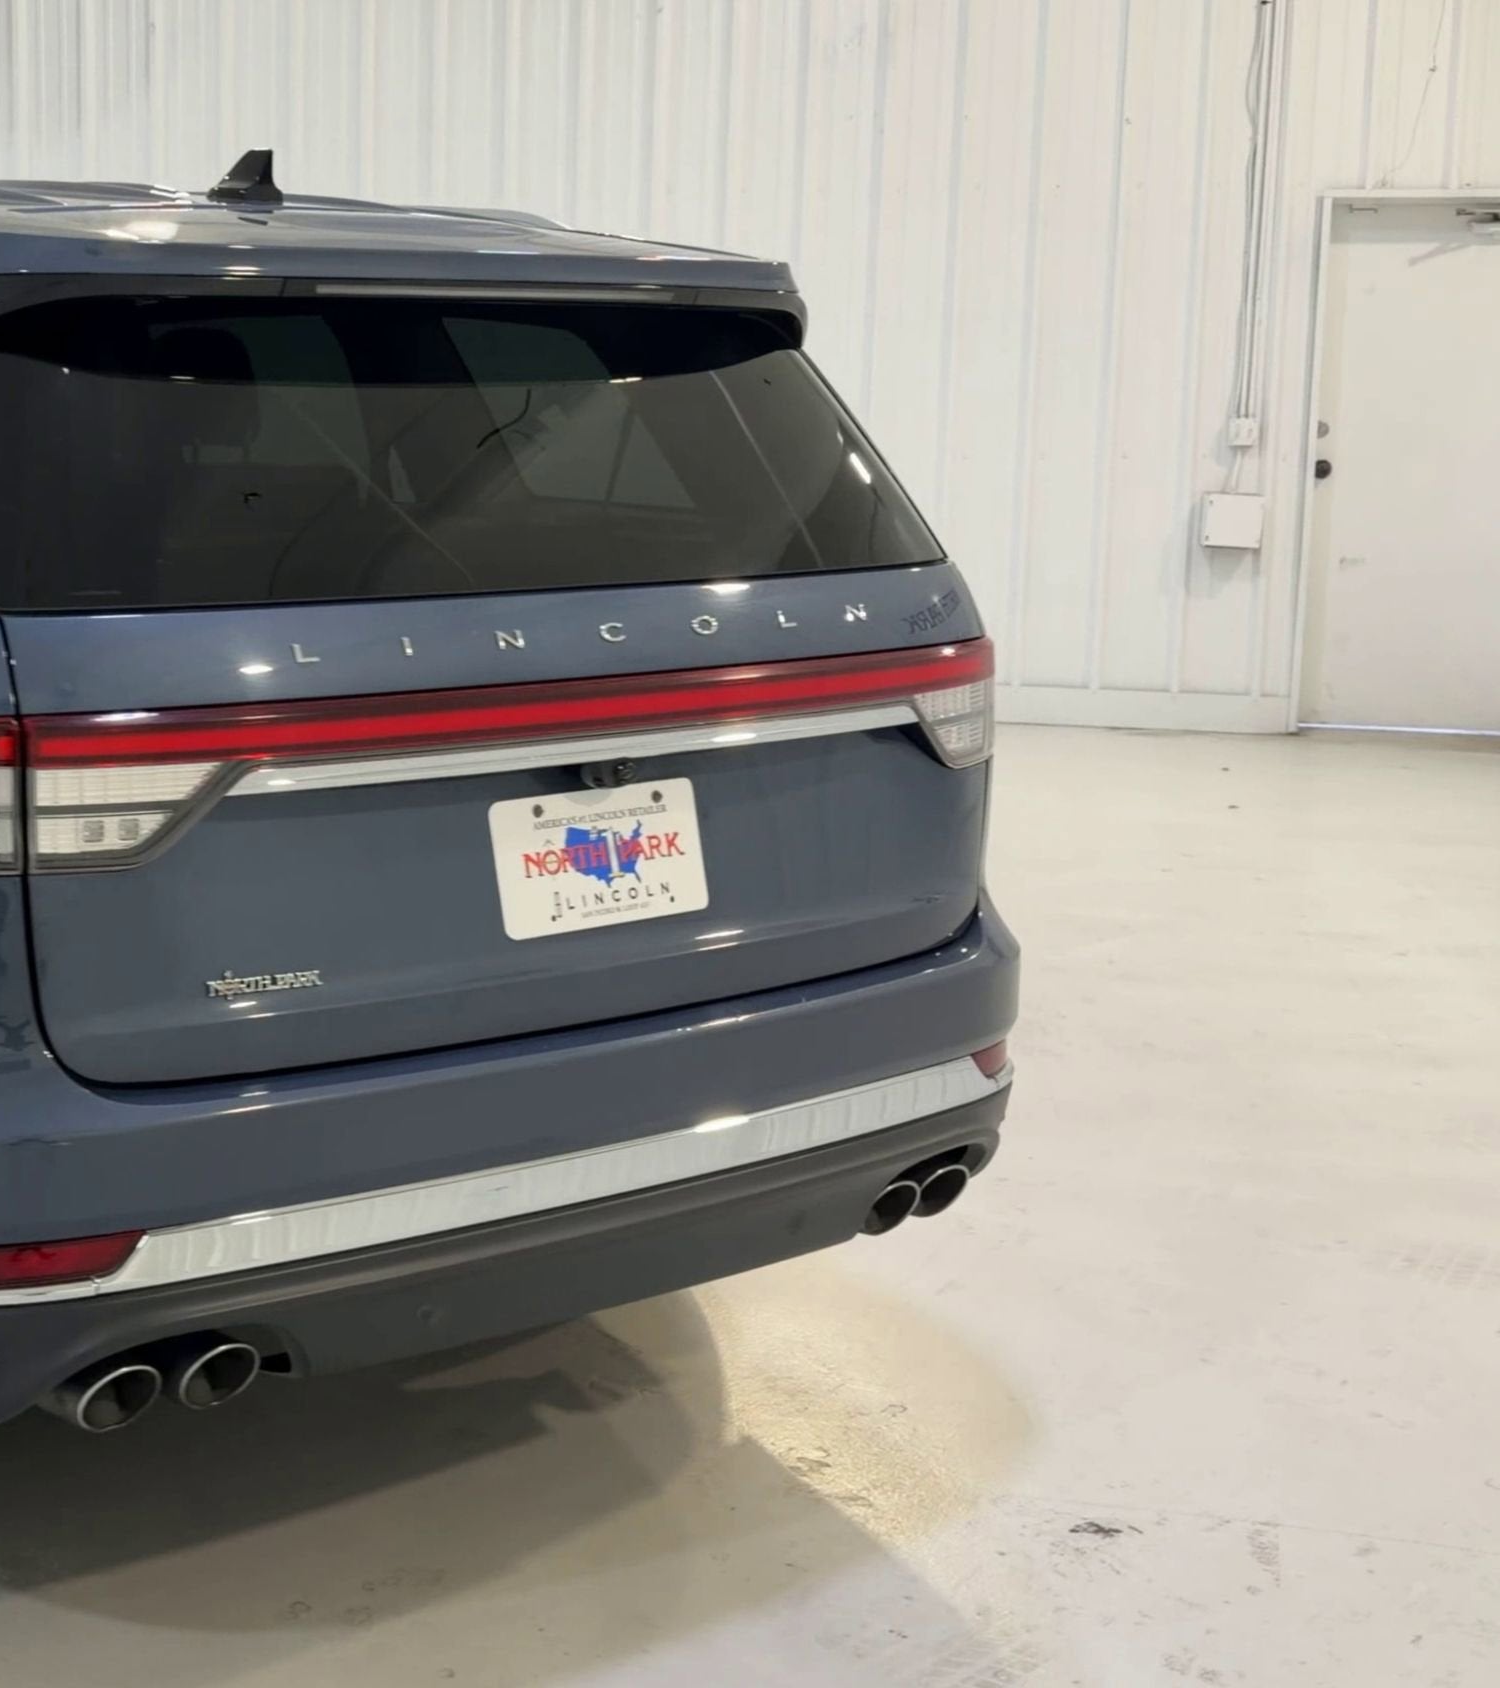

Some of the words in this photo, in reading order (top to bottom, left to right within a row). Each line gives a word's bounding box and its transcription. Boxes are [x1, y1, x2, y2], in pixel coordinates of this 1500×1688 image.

[290, 603, 867, 663] LINCOLN
[522, 844, 610, 878] NORTH
[617, 832, 685, 862] PARK
[565, 882, 671, 910] LINCOLN
